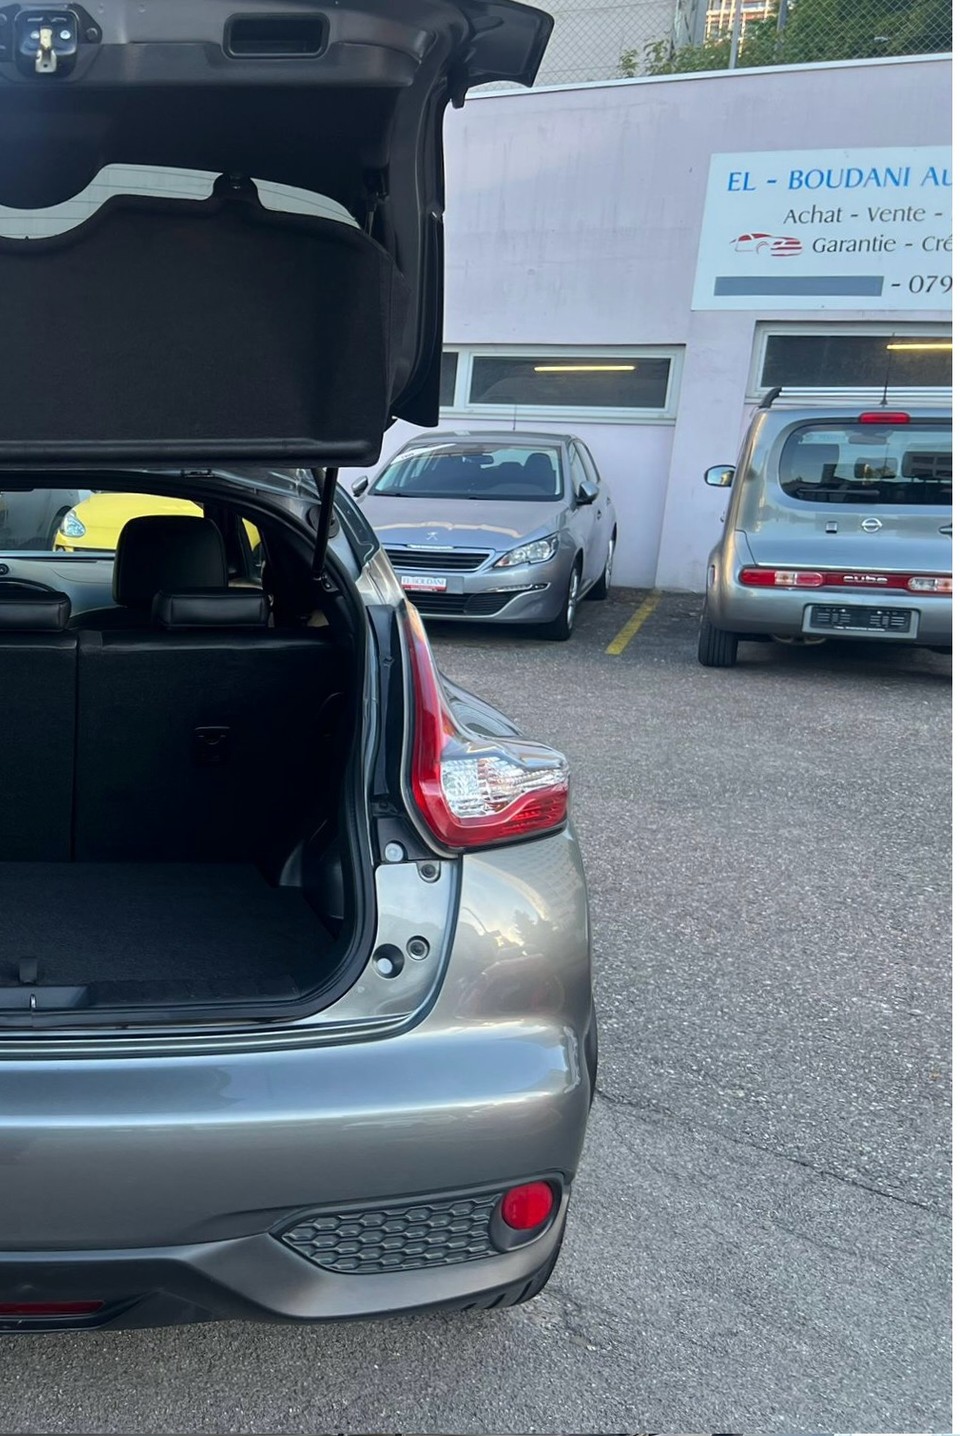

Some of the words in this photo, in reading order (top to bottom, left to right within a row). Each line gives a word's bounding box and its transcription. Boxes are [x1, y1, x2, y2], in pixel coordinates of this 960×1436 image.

[727, 172, 756, 191] EL
[788, 167, 910, 190] BOUDANI
[783, 204, 842, 224] Achat
[867, 206, 926, 223] Vente
[812, 234, 896, 253] Garantie
[908, 275, 952, 294] 079
